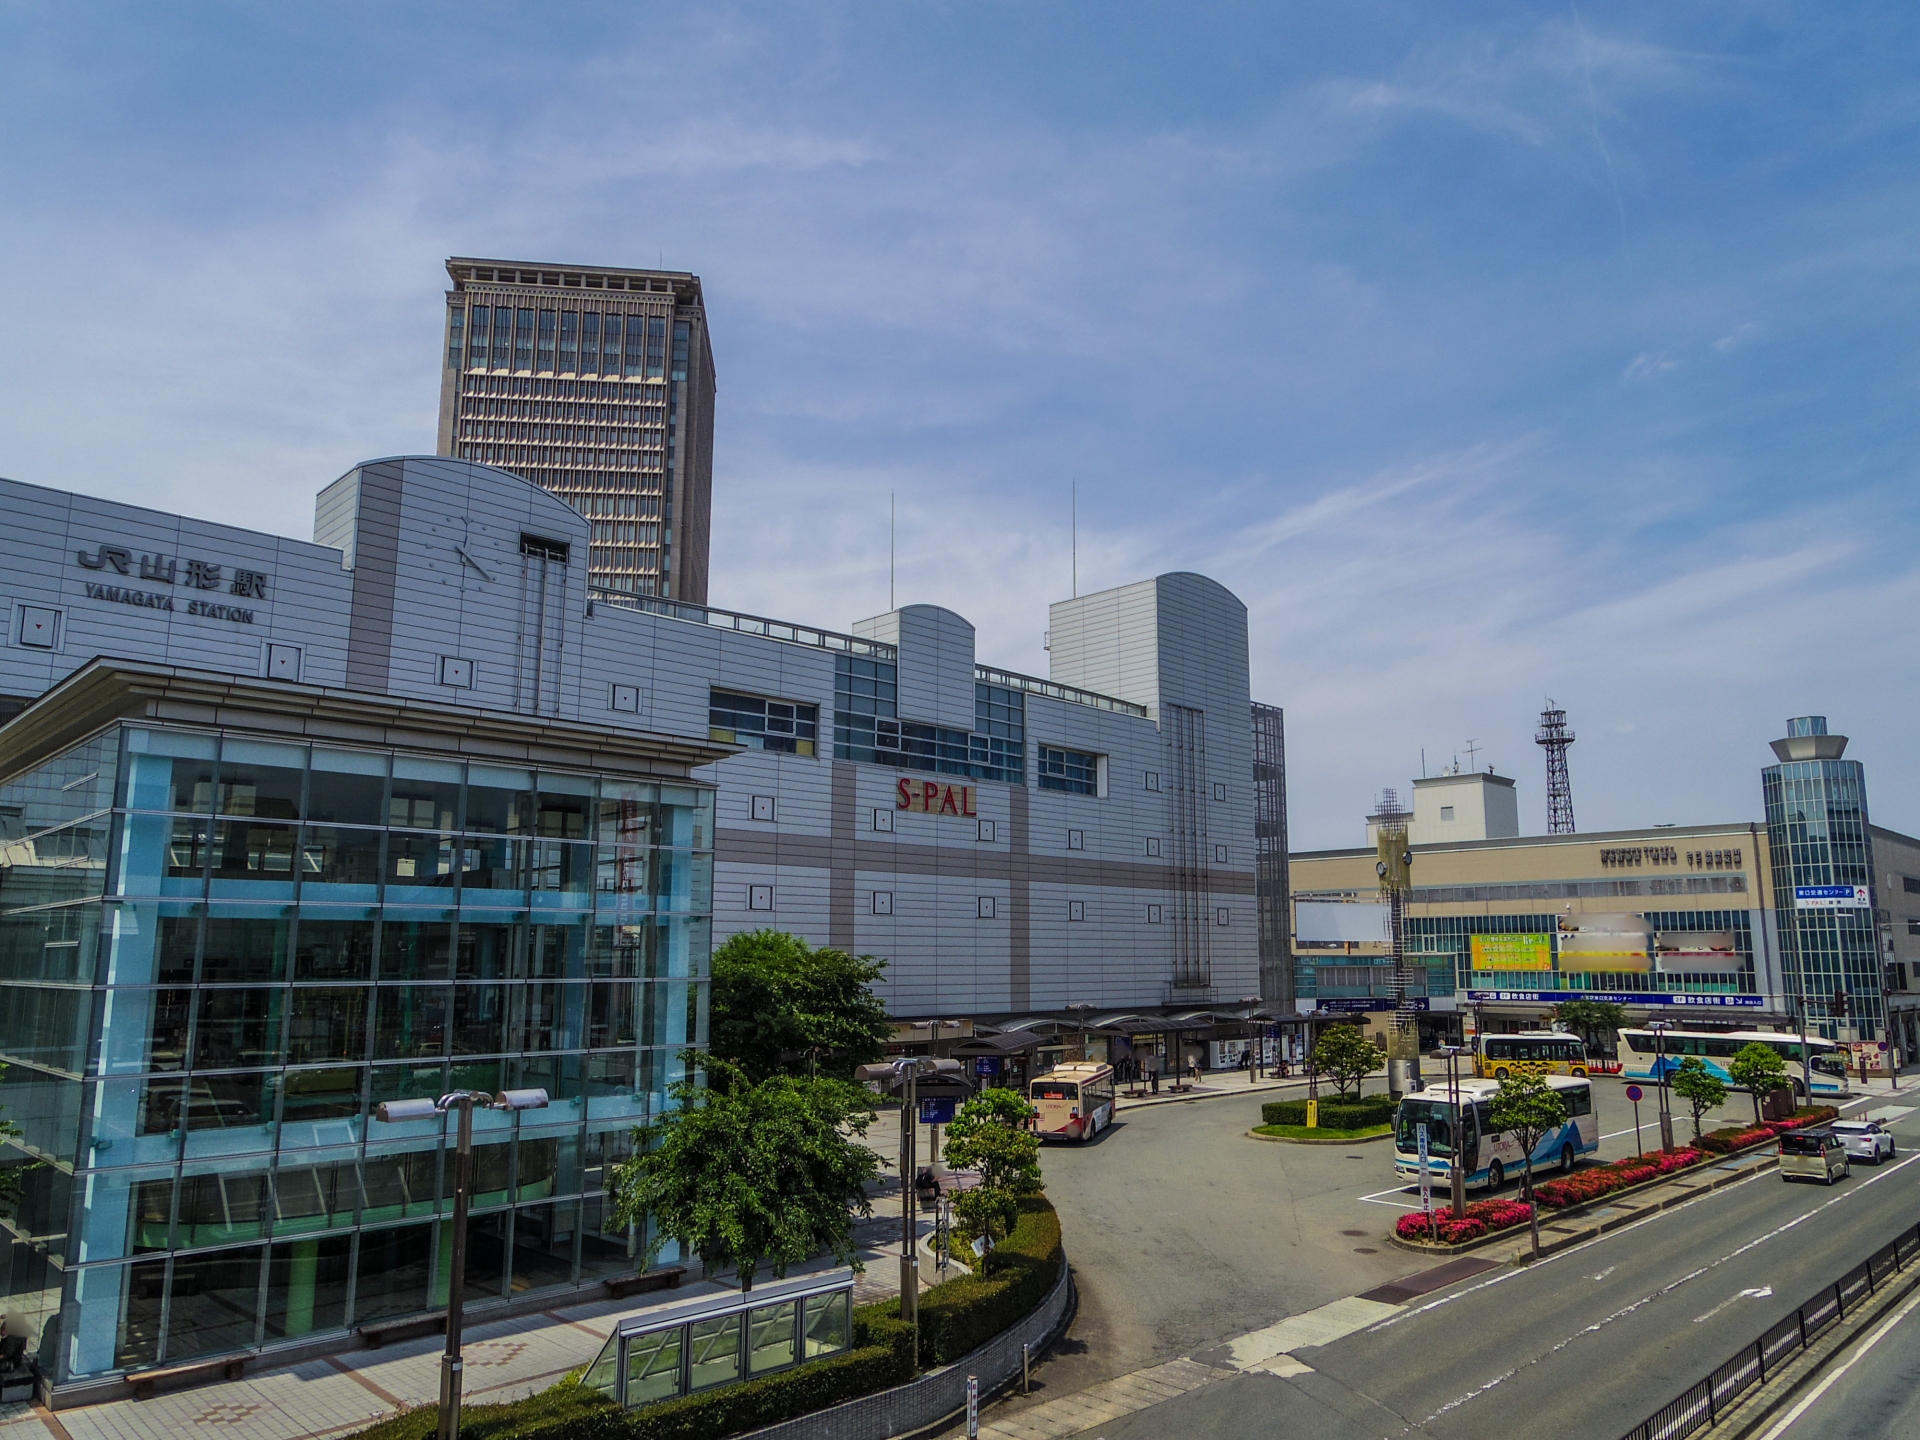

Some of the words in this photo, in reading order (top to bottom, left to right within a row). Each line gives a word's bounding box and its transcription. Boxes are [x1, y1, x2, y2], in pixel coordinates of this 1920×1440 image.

[78, 545, 267, 599] JR山形駅
[86, 582, 175, 611] YAMAGATA
[188, 600, 254, 624] STATION
[898, 778, 977, 817] S-PAL
[1687, 996, 1721, 1004] 飲食店街
[1419, 1125, 1427, 1163] バス専用入口
